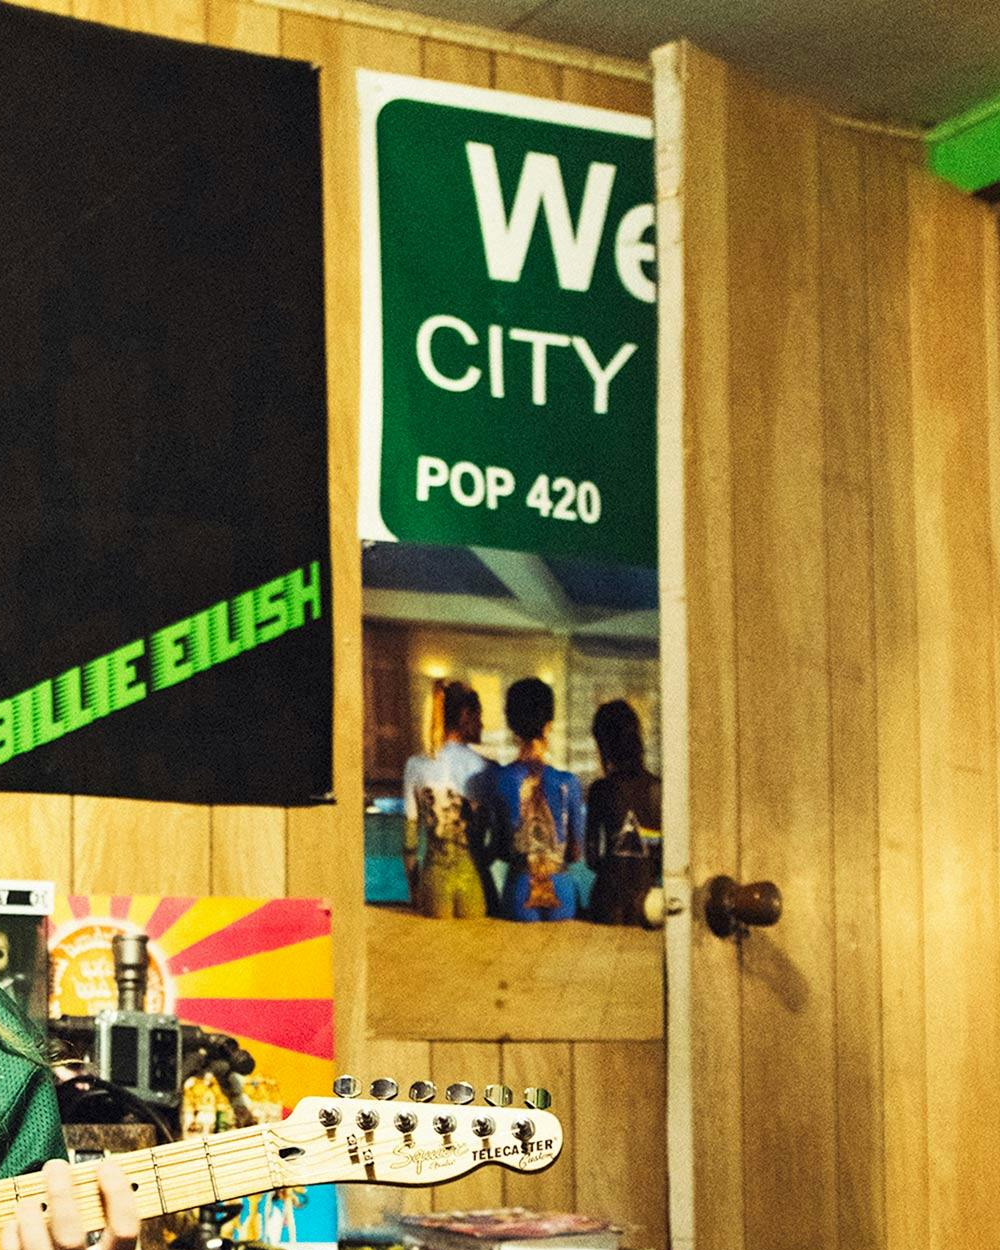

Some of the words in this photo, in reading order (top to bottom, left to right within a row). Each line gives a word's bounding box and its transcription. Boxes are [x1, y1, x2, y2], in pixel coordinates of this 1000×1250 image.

[416, 315, 638, 414] CITY
[416, 455, 515, 509] POP
[526, 474, 601, 524] 420
[149, 561, 321, 692] EILISH
[472, 1139, 553, 1161] TELECASTER
